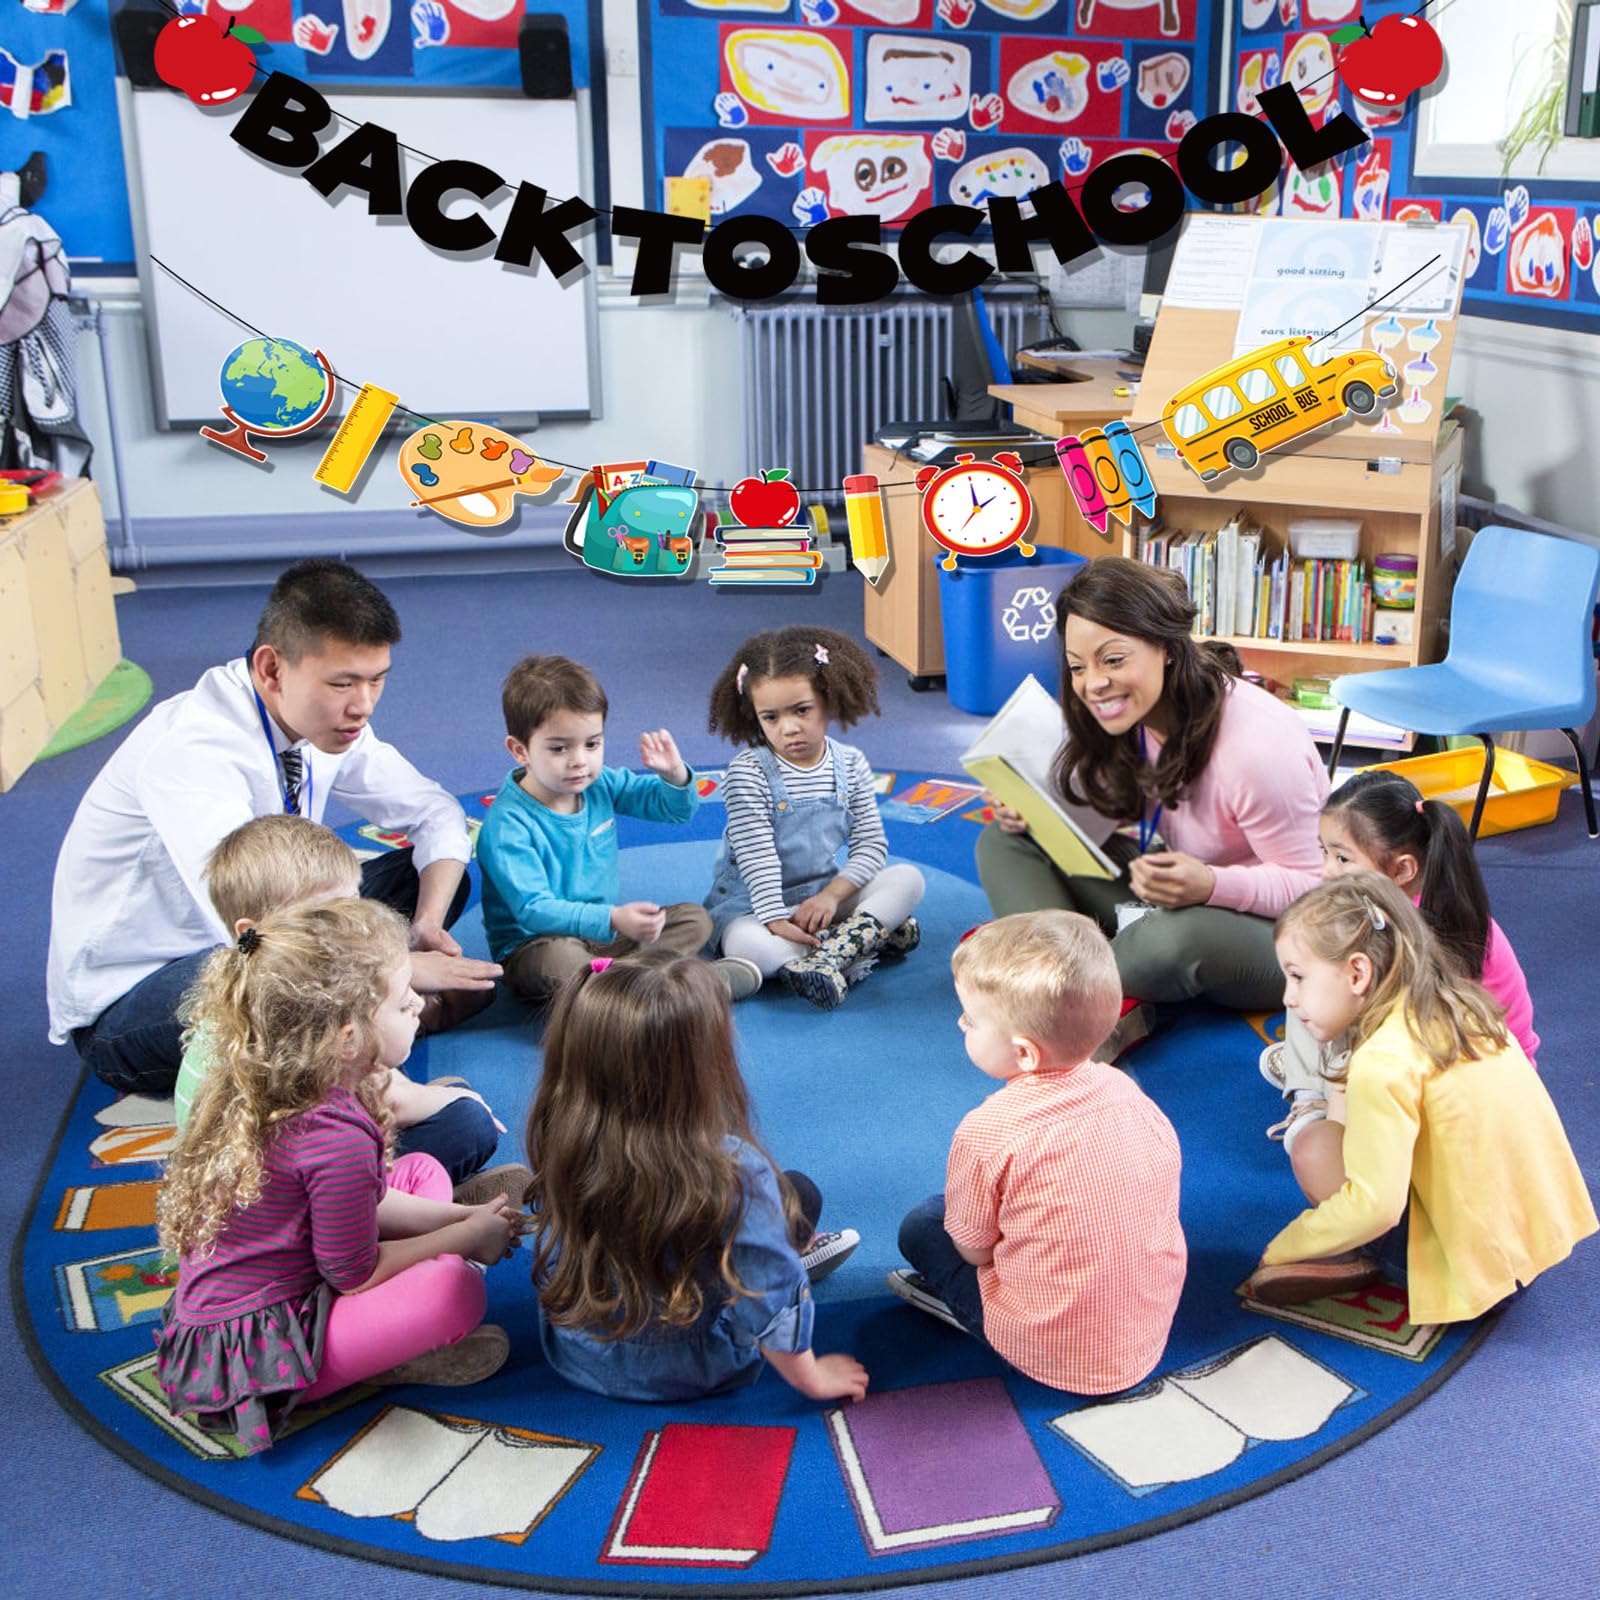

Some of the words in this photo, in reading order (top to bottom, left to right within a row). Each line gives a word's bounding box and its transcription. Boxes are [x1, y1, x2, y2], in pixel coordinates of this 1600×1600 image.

[1277, 266, 1306, 277] good
[1309, 267, 1346, 280] sitting
[1260, 328, 1285, 336] ears
[1289, 327, 1339, 340] listening
